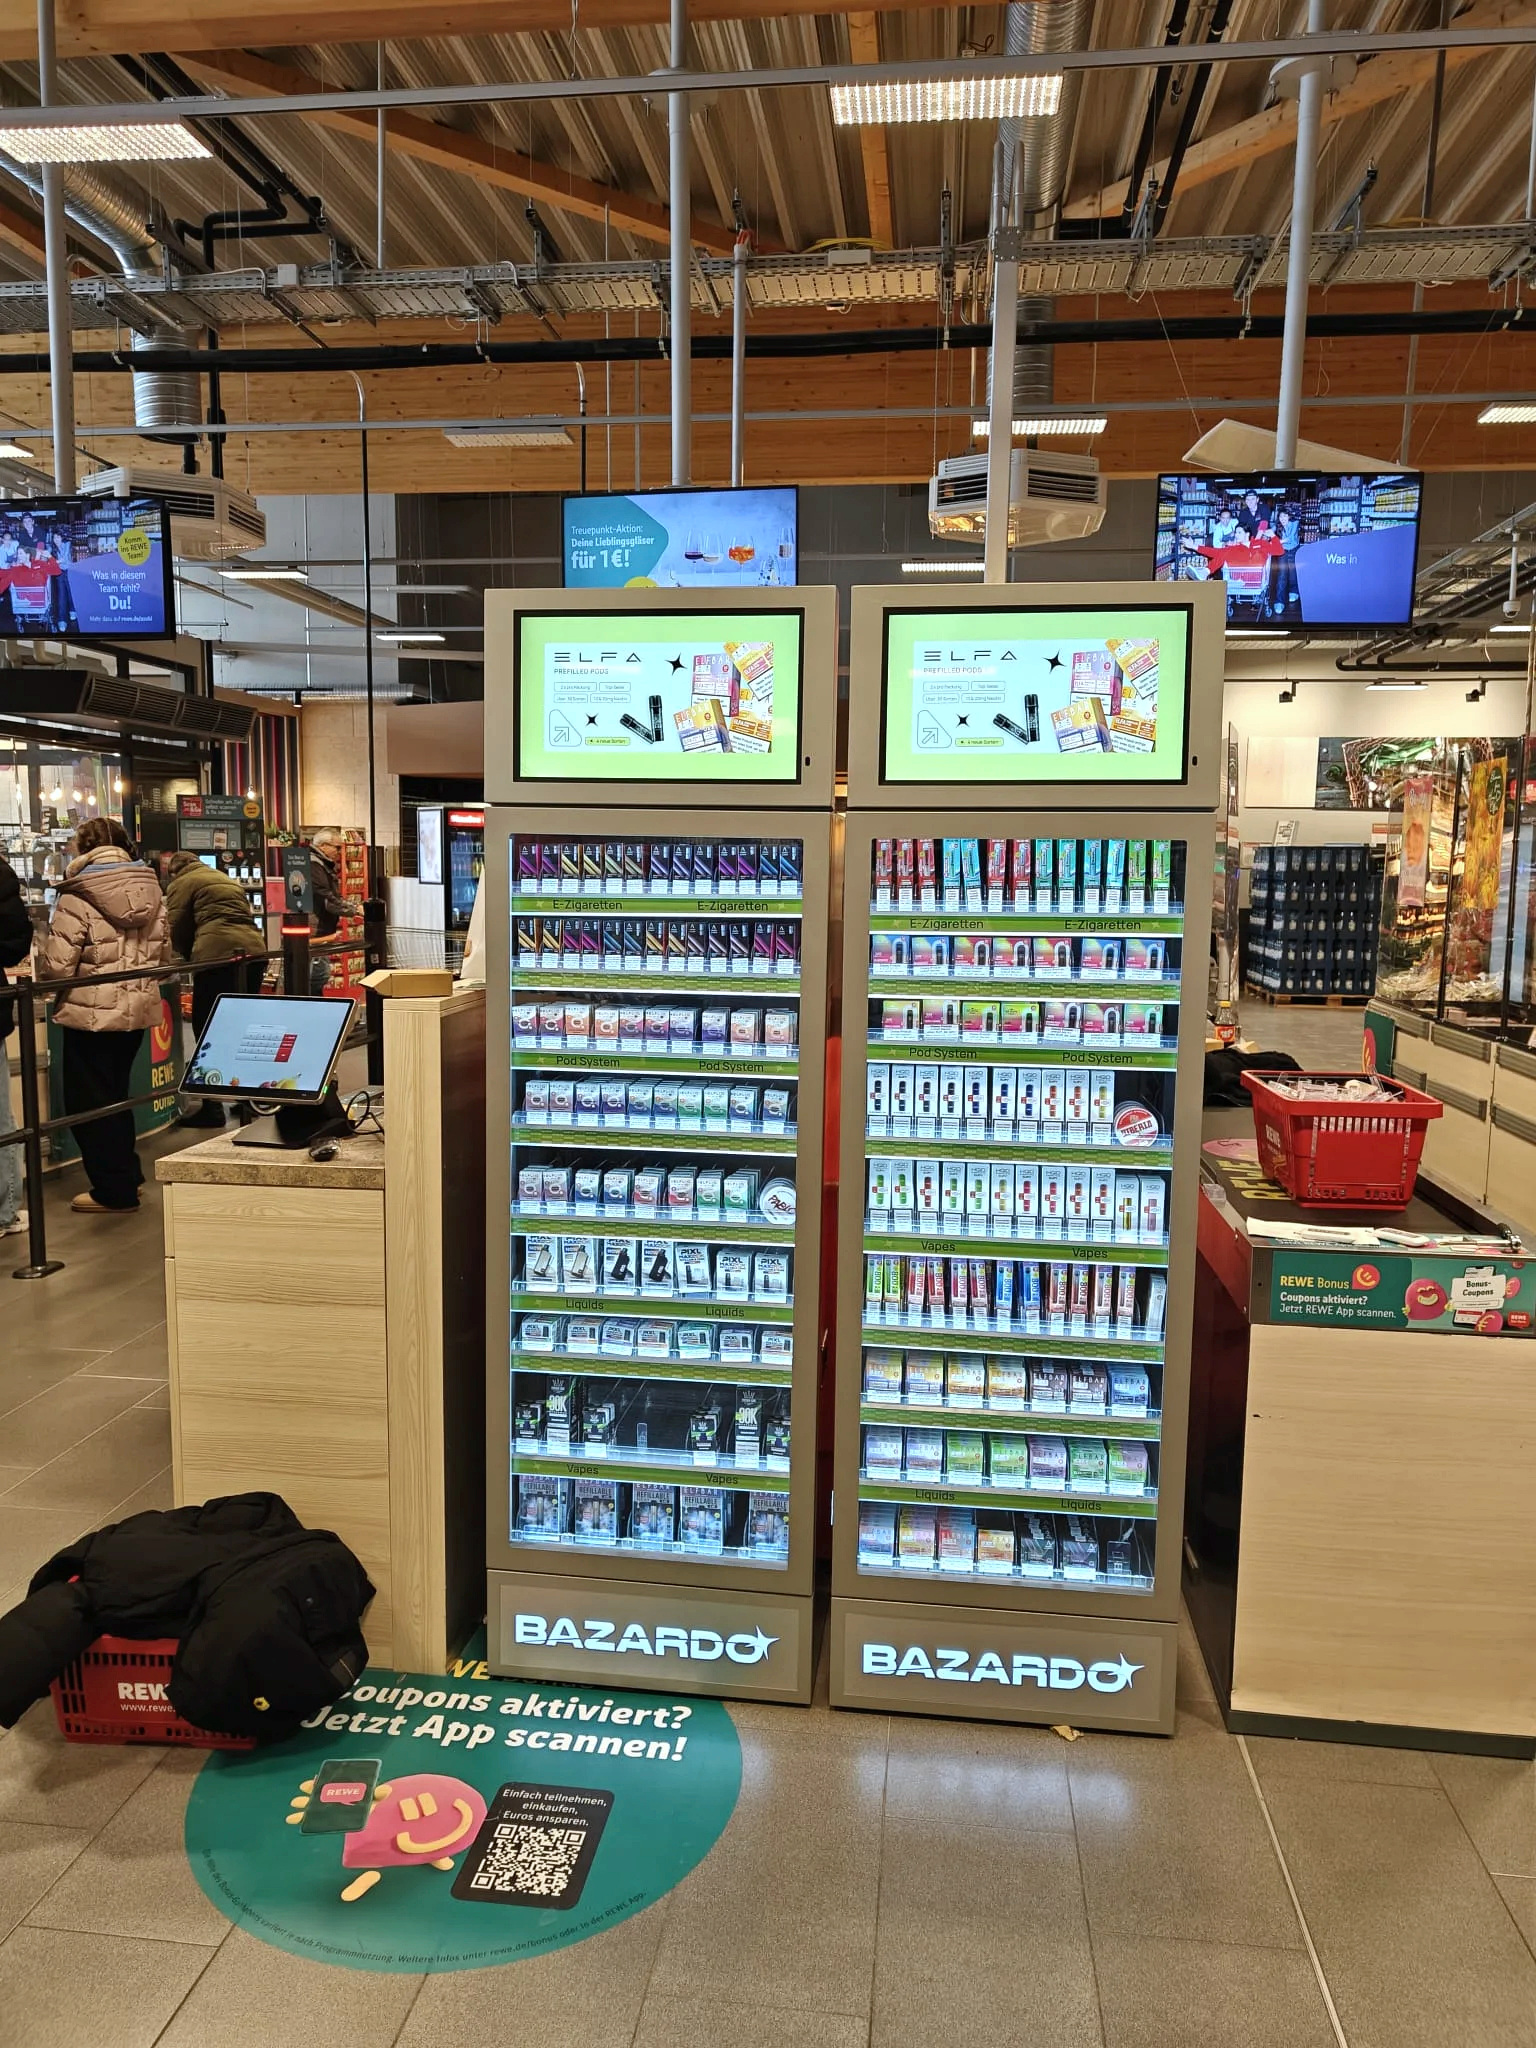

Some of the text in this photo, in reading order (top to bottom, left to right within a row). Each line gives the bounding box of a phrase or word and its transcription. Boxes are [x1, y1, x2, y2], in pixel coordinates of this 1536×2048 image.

[571, 525, 643, 536] Treuepunkt-Aktion:
[130, 542, 148, 551] REWE
[571, 536, 655, 549] Deine Lieblingsgläser
[127, 552, 144, 560] Team!
[571, 549, 630, 569] für 1€!
[1326, 554, 1358, 565] Was in
[92, 570, 146, 580] Was in diesem
[99, 583, 141, 593] Team fehlt?
[109, 595, 131, 610] Du!
[554, 652, 642, 663] ELFA
[923, 650, 1017, 662] ELFA
[554, 667, 589, 675] PREFILLED
[553, 900, 623, 911] E-Zigaretten
[697, 901, 769, 913] E-Zigaretten
[910, 919, 984, 931] E-Zigaretten
[1065, 919, 1141, 932] E-Zigaretten
[909, 1047, 977, 1060] Pod System
[1062, 1052, 1133, 1065] Pod System
[556, 1055, 620, 1067] Pod System
[699, 1061, 764, 1073] Pod System
[151, 1062, 175, 1088] REWE
[921, 1240, 956, 1253] Vapes
[1072, 1247, 1108, 1260] Vapes
[722, 1256, 744, 1264] PIXL
[1280, 1275, 1350, 1290] REWE Bonus
[1466, 1280, 1492, 1288] Bonus-
[1280, 1292, 1368, 1306] Coupons aktiviert?
[1462, 1289, 1494, 1298] Coupons
[566, 1300, 604, 1311] Liquids
[1279, 1303, 1397, 1319] Jetzt REWE App scannen.
[705, 1306, 745, 1318] Liquids
[1033, 1373, 1065, 1381] ELFBAR
[1072, 1375, 1105, 1384] ELFBAR
[567, 1463, 599, 1475] Vapes
[705, 1473, 739, 1485] Vapes
[915, 1488, 955, 1501] Liquids
[1061, 1499, 1102, 1511] Liquids
[514, 1613, 779, 1664] BAZARDO
[448, 1658, 491, 1681] WE
[862, 1643, 1145, 1694] BAZARDO
[117, 1682, 170, 1701] REW
[120, 1703, 176, 1713] www.rewe.
[499, 1693, 693, 1730] aktiviert?
[300, 1705, 688, 1762] Jetzt App scannen!
[326, 1786, 361, 1797] REWE
[502, 1788, 608, 1808] Einfach teilnehmen,
[522, 1801, 579, 1816] einkaufen,
[503, 1810, 590, 1827] Euros ansparen.
[398, 1954, 434, 1963] Weitere
[436, 1953, 460, 1963] Infos
[462, 1951, 488, 1960] unter
[559, 1924, 579, 1938] oder
